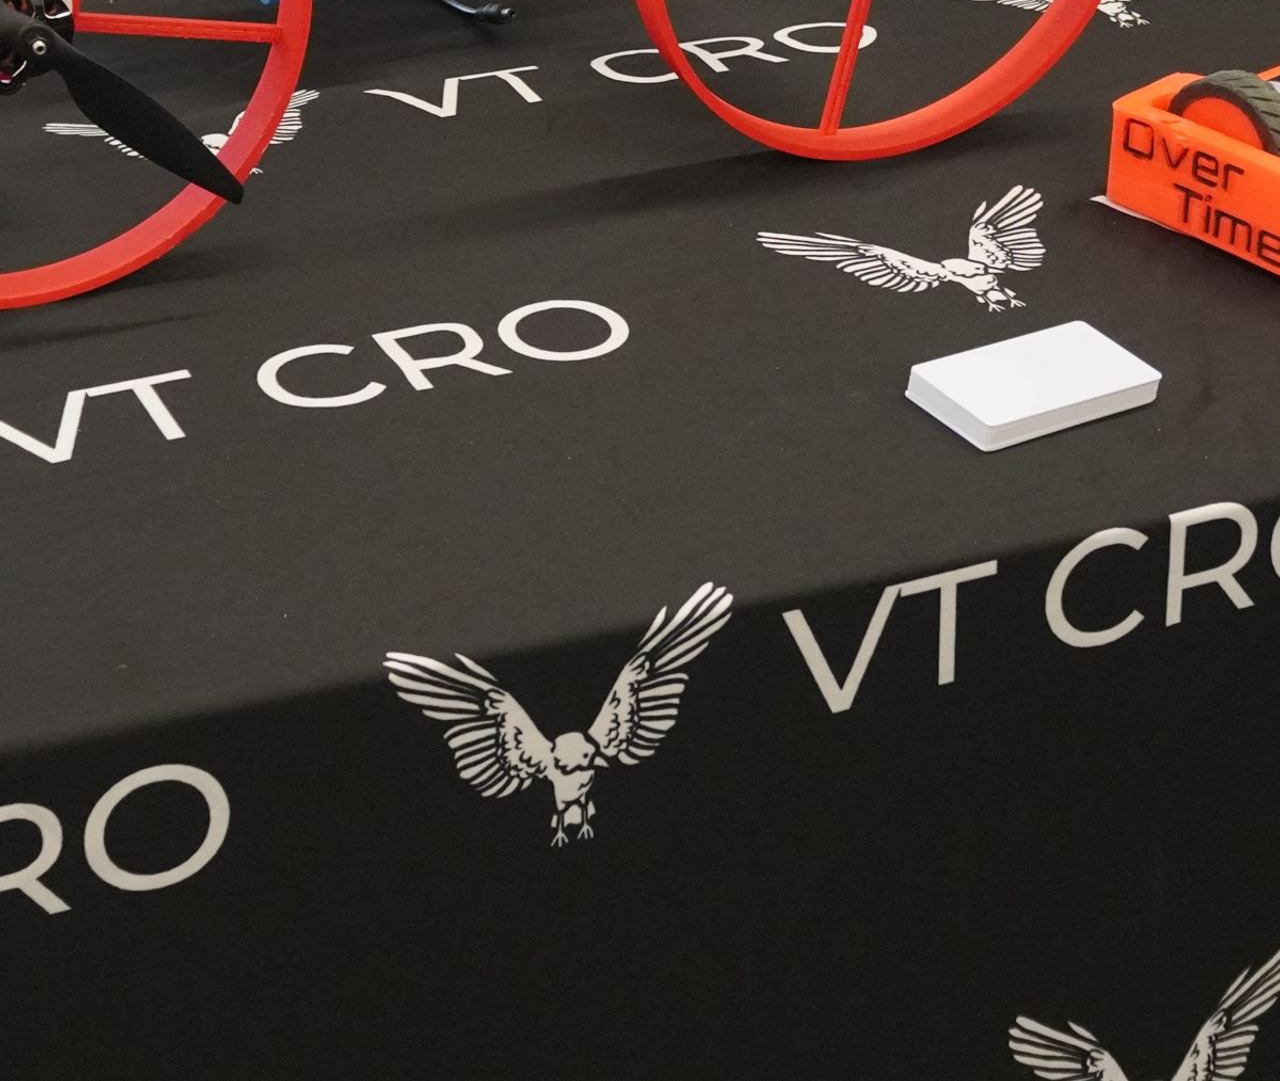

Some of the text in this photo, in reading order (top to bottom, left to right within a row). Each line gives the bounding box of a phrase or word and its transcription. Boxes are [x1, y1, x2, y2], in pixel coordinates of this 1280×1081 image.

[364, 22, 877, 117] VT CRO
[1121, 119, 1245, 193] Over
[257, 300, 629, 407] CRO
[783, 560, 997, 713] VT
